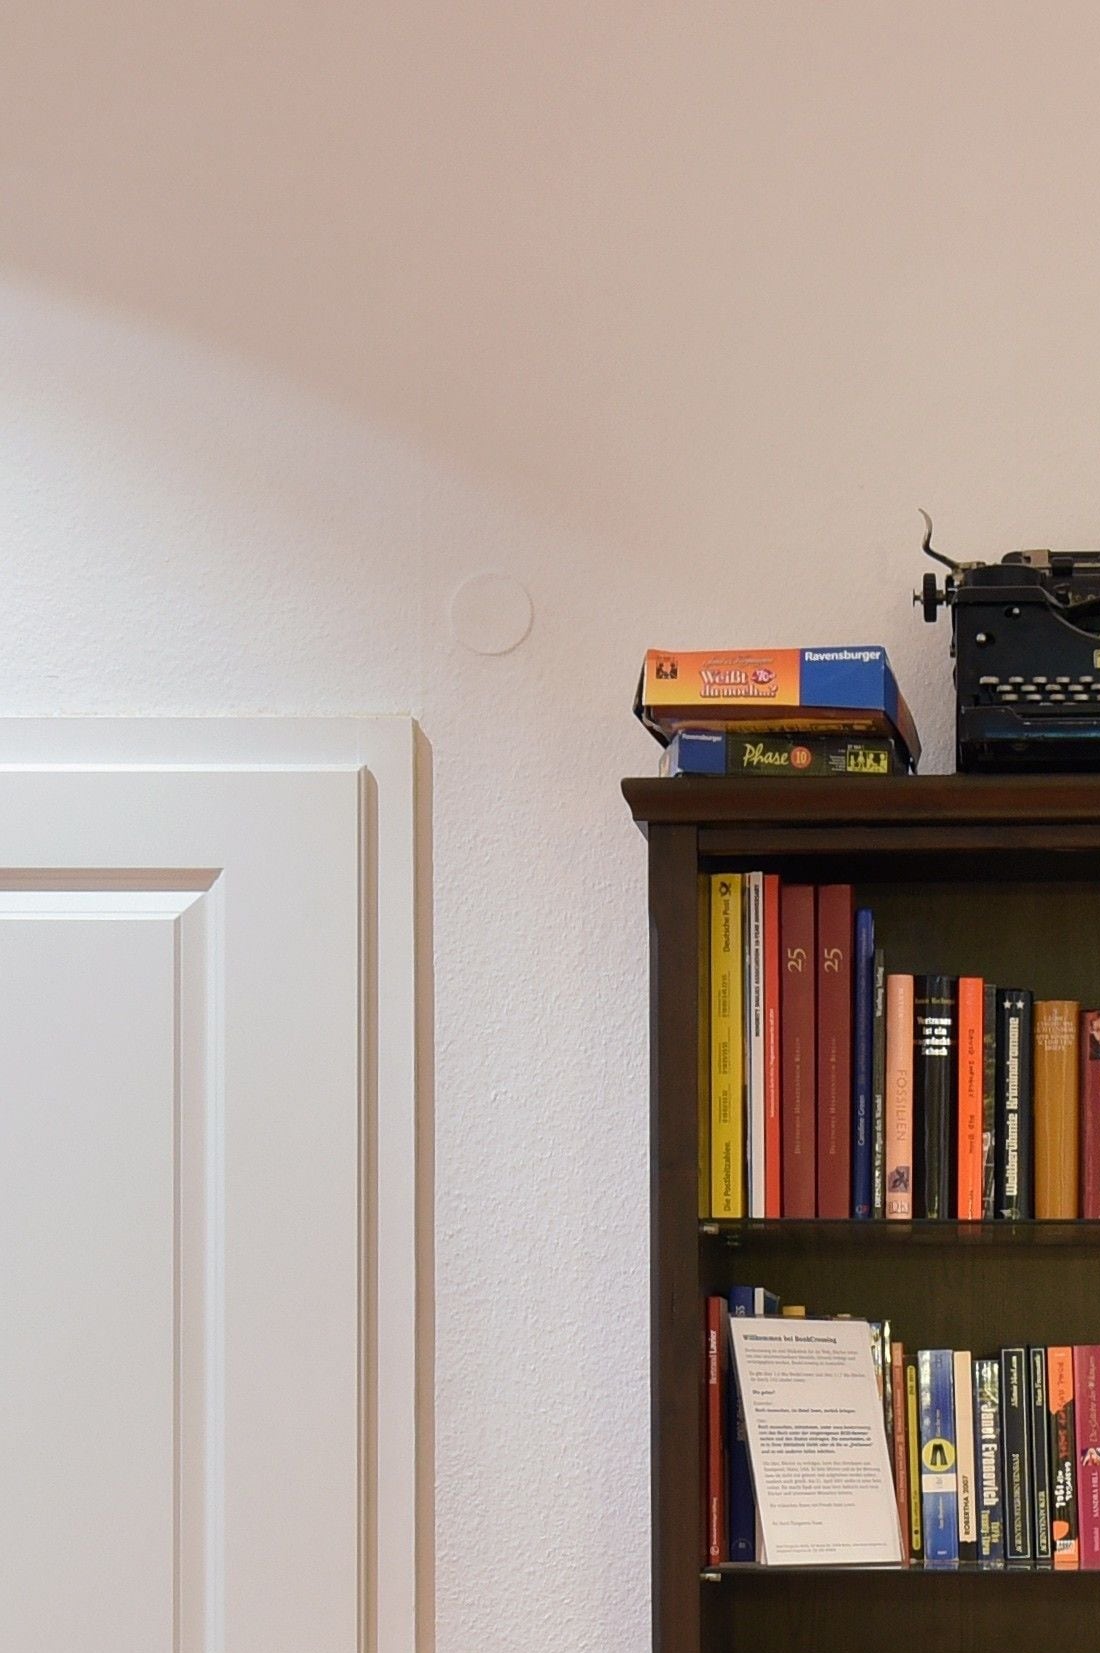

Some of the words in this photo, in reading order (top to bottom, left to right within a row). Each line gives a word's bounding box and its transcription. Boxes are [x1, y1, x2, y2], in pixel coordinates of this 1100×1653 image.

[805, 650, 881, 663] Ravensburger
[700, 670, 748, 685] Weißt
[700, 684, 717, 698] du
[681, 732, 723, 743] Ravensburger
[743, 744, 790, 768] Phase
[794, 752, 808, 765] 10
[722, 898, 730, 914] Post
[722, 916, 730, 952] Deutsche
[786, 948, 806, 972] 25
[824, 948, 844, 972] 25
[1006, 1016, 1020, 1110] Kriminalromane
[856, 1094, 866, 1116] Green
[896, 1070, 908, 1142] FOSSILIEN
[856, 1118, 866, 1146] Caroline
[1006, 1112, 1018, 1196] Weltberühmte
[722, 1200, 732, 1212] Die
[982, 1404, 996, 1438] Janet
[962, 1474, 970, 1494] 2007
[982, 1444, 998, 1506] Evanovich
[962, 1494, 970, 1534] ROBERTHA
[1092, 1490, 1100, 1518] SANDRA
